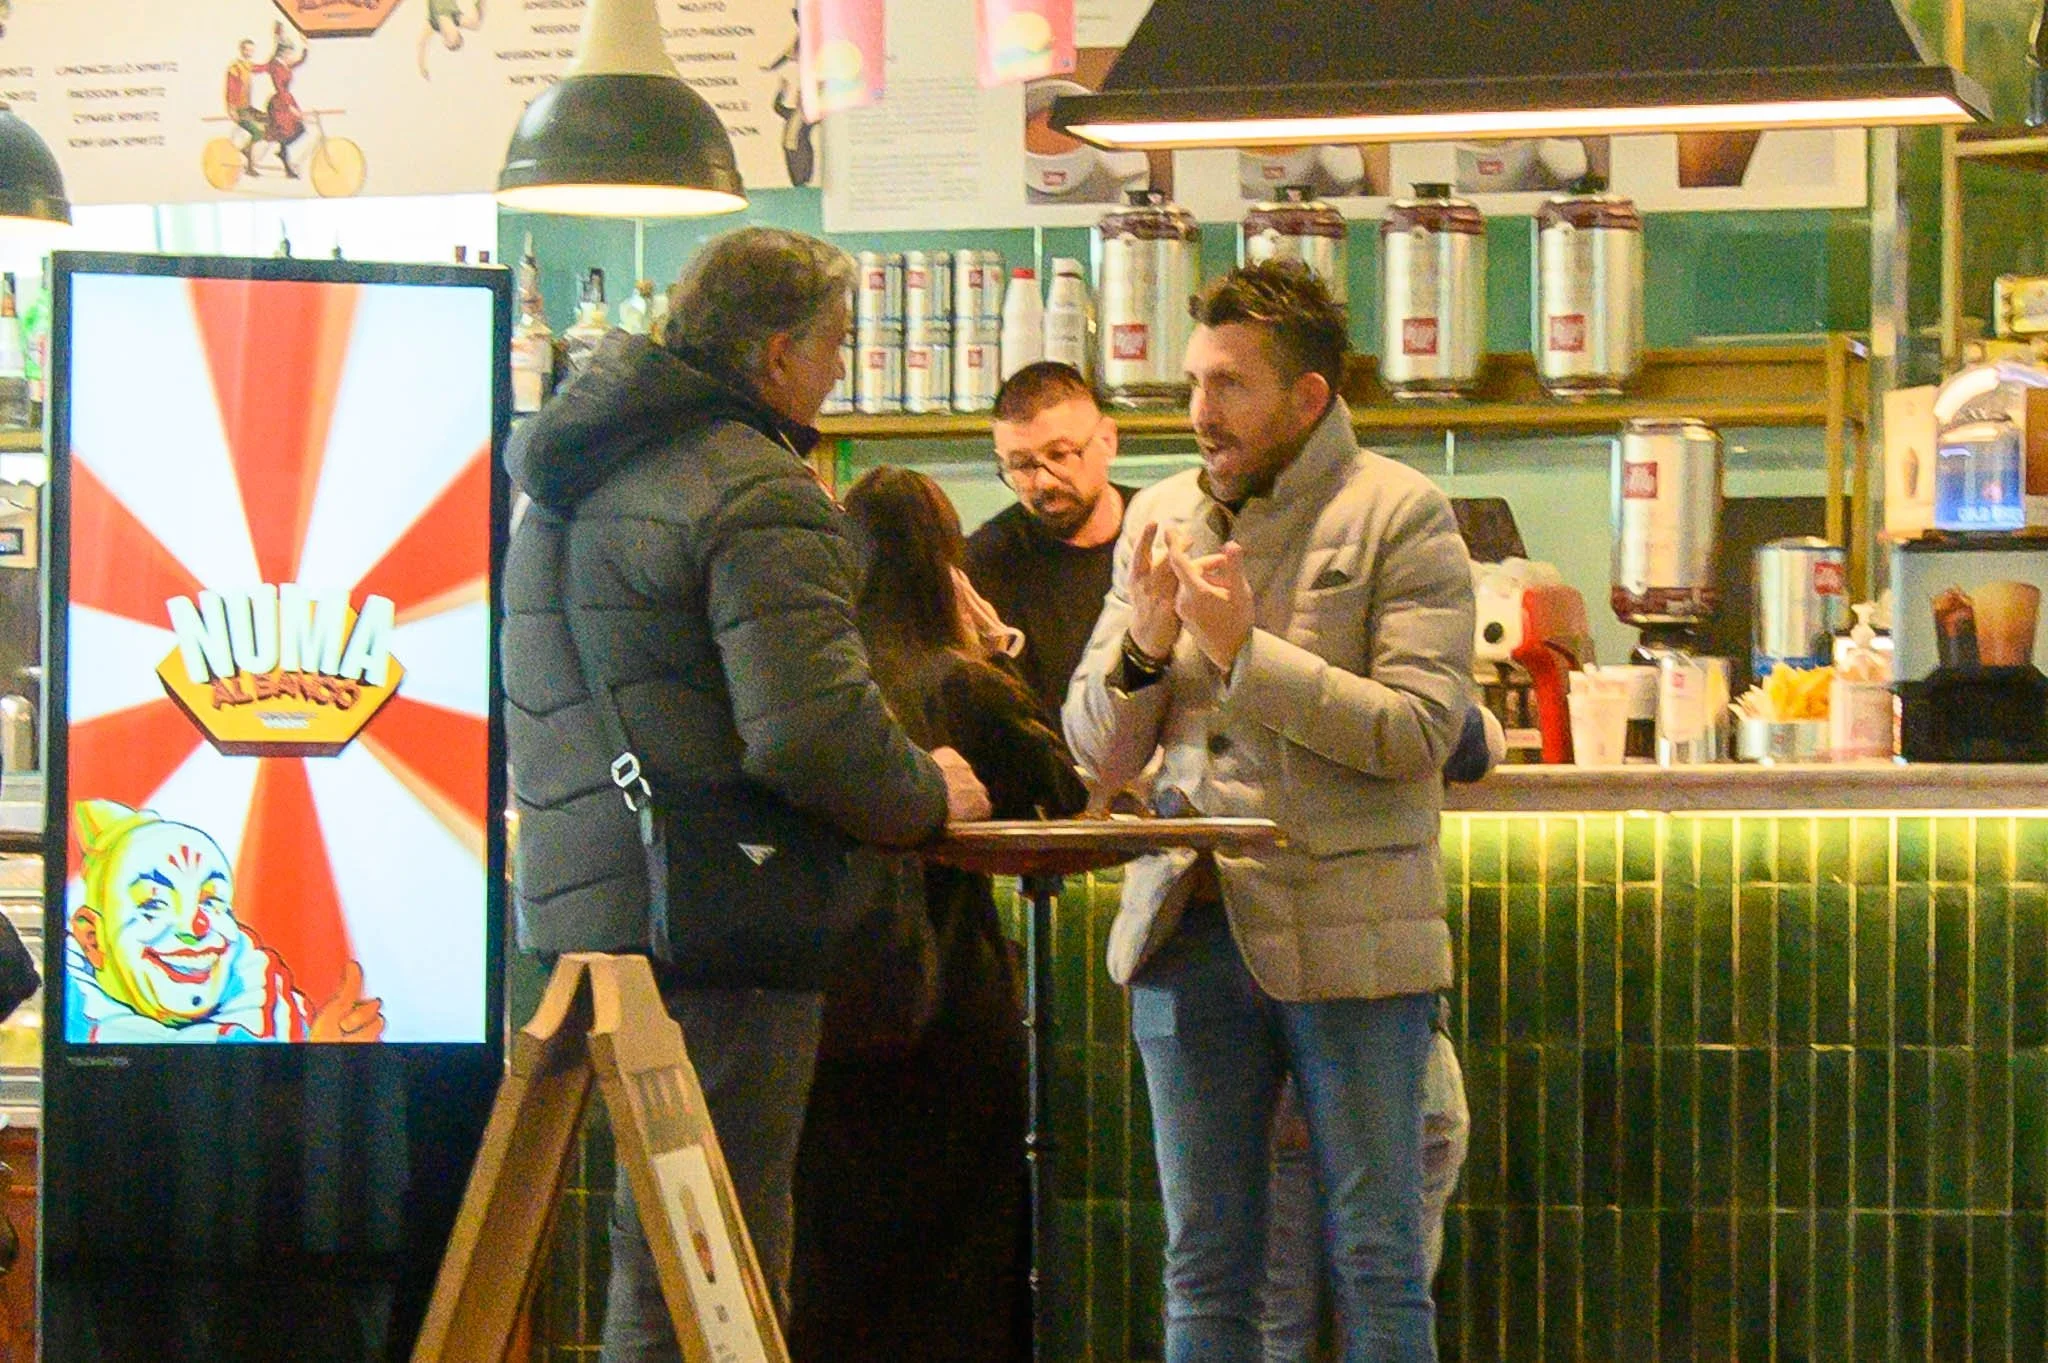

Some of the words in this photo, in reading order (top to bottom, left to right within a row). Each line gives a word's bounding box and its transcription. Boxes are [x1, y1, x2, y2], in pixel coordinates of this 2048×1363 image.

[166, 582, 396, 687] NUMA
[212, 677, 253, 710] AL
[251, 672, 362, 711] BANCO
